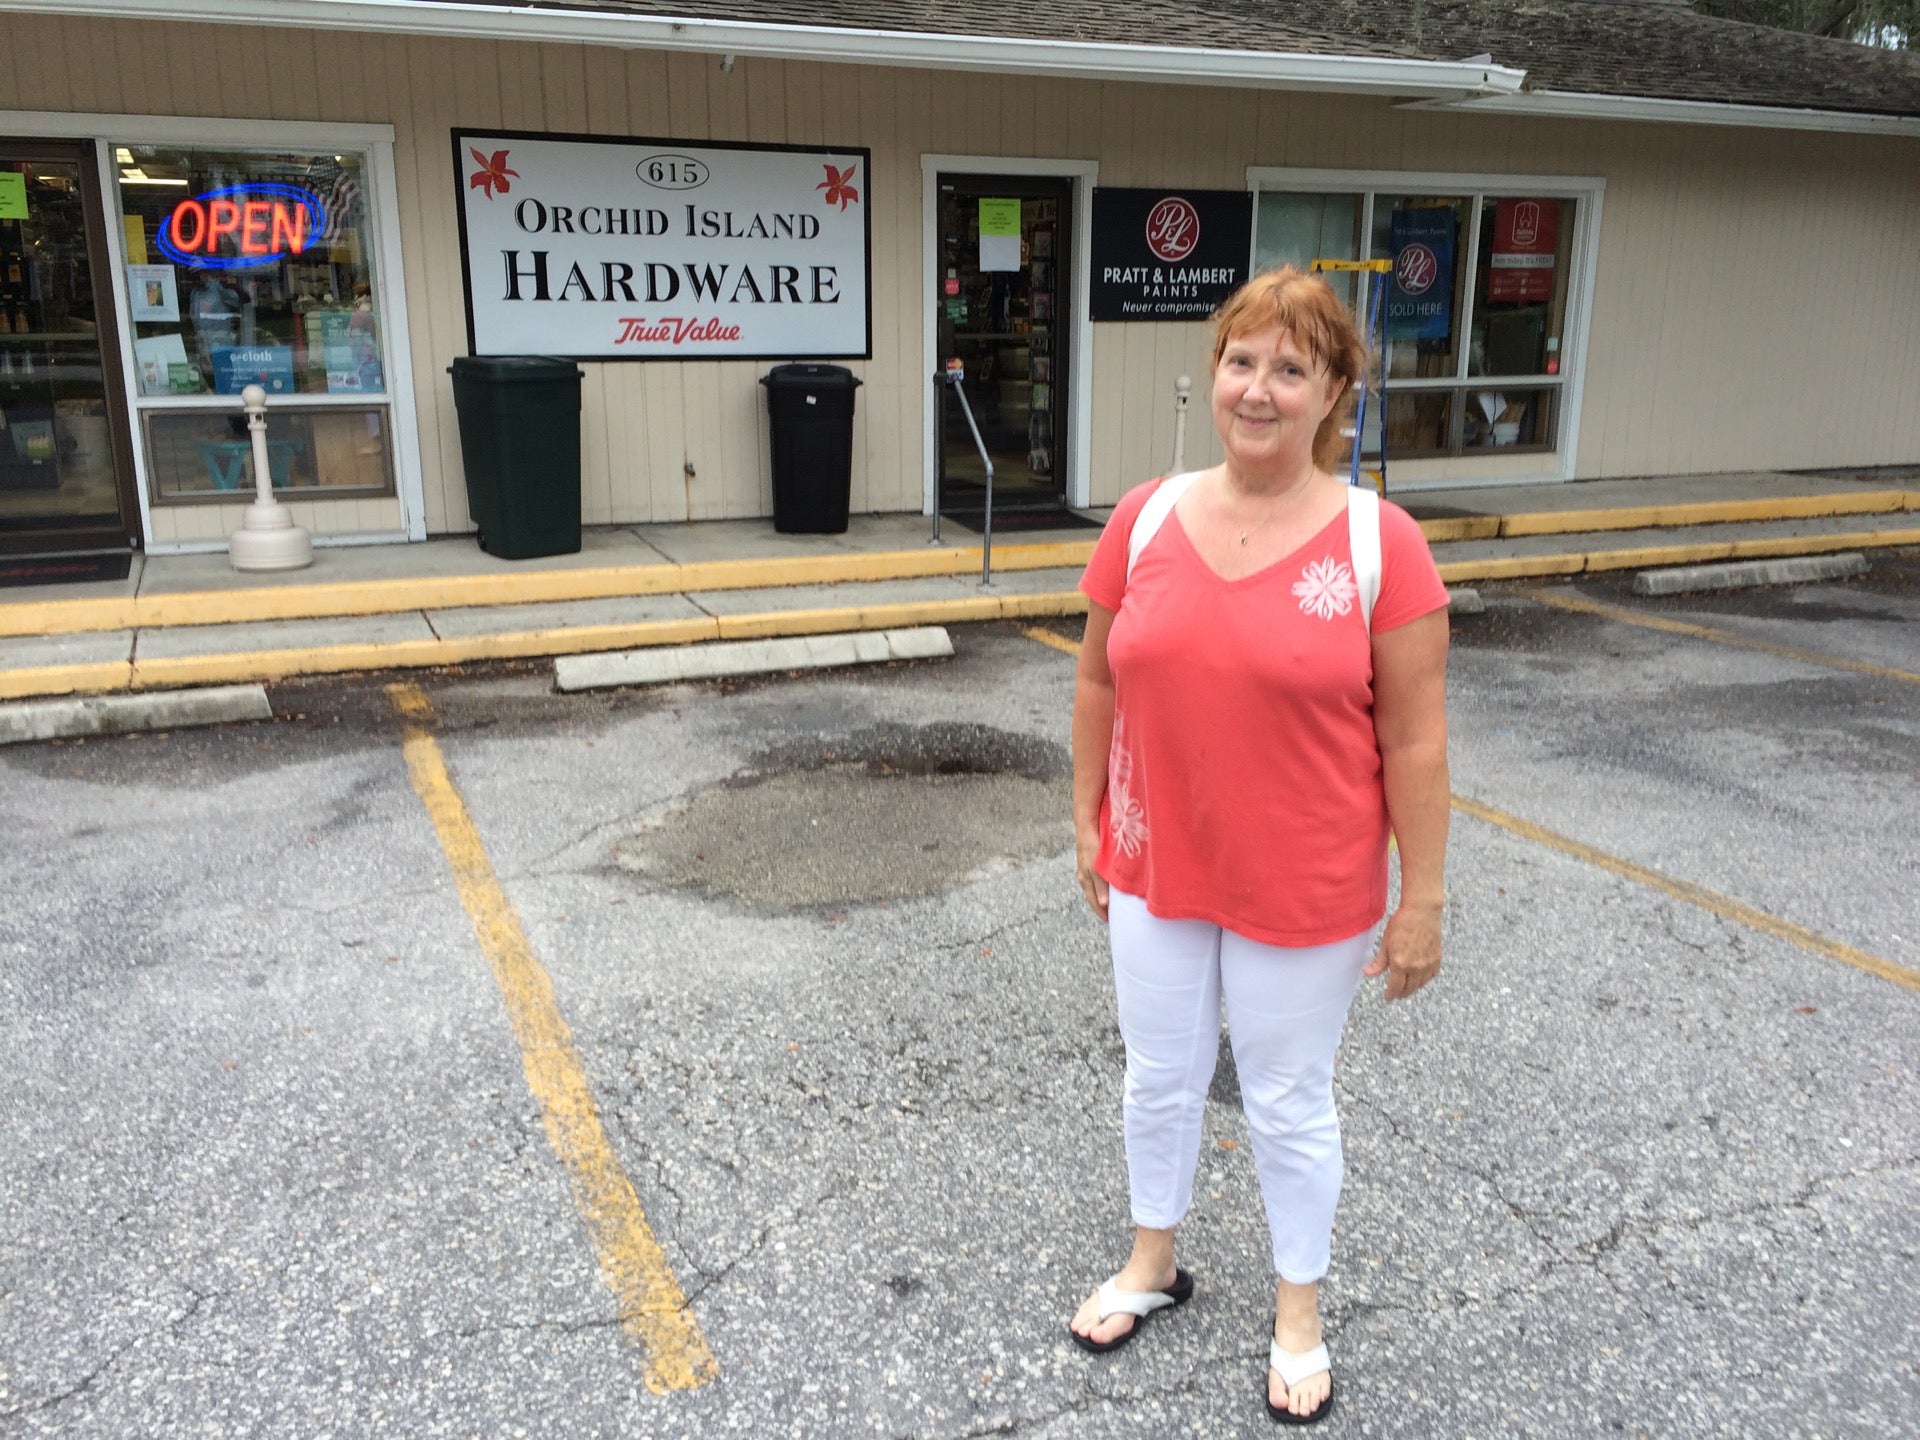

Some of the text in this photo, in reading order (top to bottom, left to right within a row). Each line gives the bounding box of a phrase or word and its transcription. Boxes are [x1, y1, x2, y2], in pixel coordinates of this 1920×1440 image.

[648, 161, 699, 184] 615
[170, 199, 306, 254] OPEN
[514, 198, 820, 240] ORCHID ISLAND
[501, 249, 841, 305] HARDWARE
[1103, 267, 1236, 284] PRATT & LAMBERT
[1143, 285, 1198, 297] PAINTS
[1122, 301, 1216, 315] Never compromise
[1389, 302, 1443, 317] SOLD HERE
